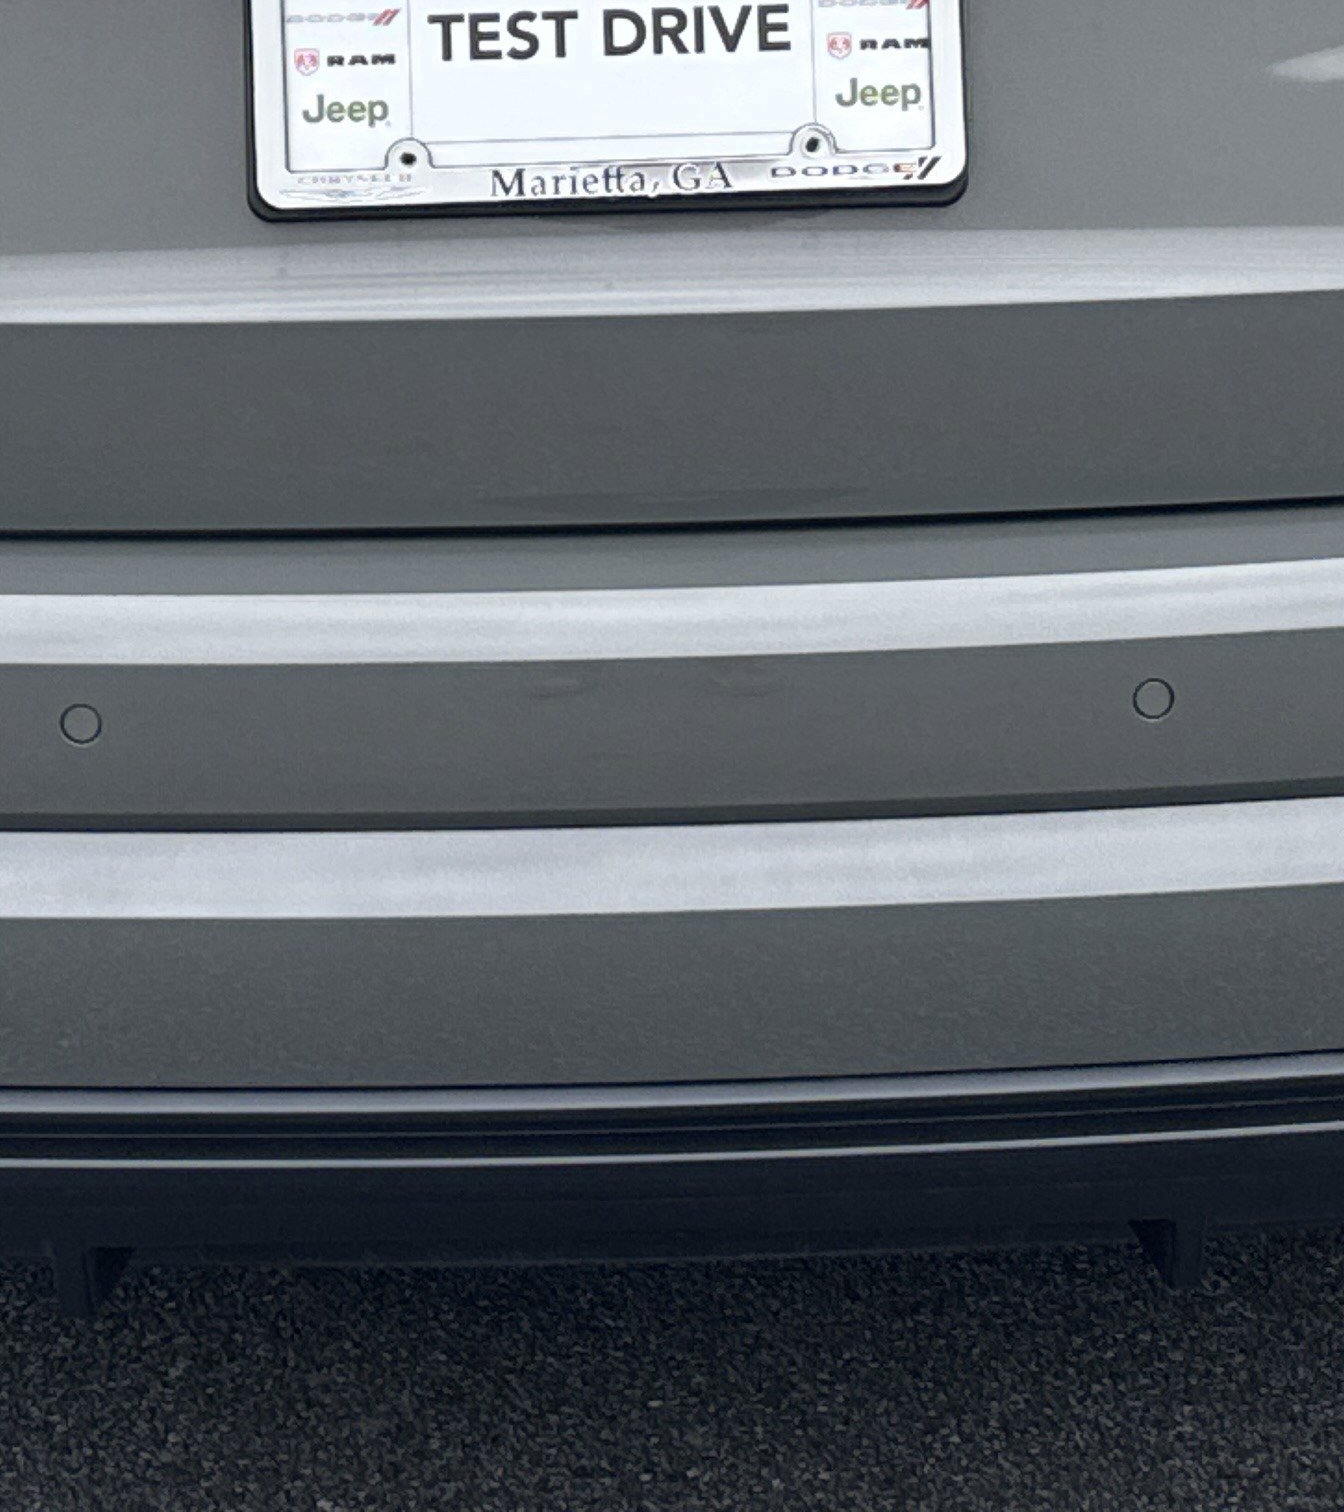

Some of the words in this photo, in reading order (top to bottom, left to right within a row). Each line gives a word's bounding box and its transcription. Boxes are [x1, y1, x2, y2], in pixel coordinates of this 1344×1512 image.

[427, 9, 578, 62] TEST
[602, 3, 792, 57] DRIVE
[859, 38, 930, 50] RAM
[326, 54, 396, 67] RAM
[302, 93, 389, 128] Jeep
[835, 77, 922, 111] Jeep
[489, 166, 659, 197] Marietta,
[672, 161, 734, 191] GA
